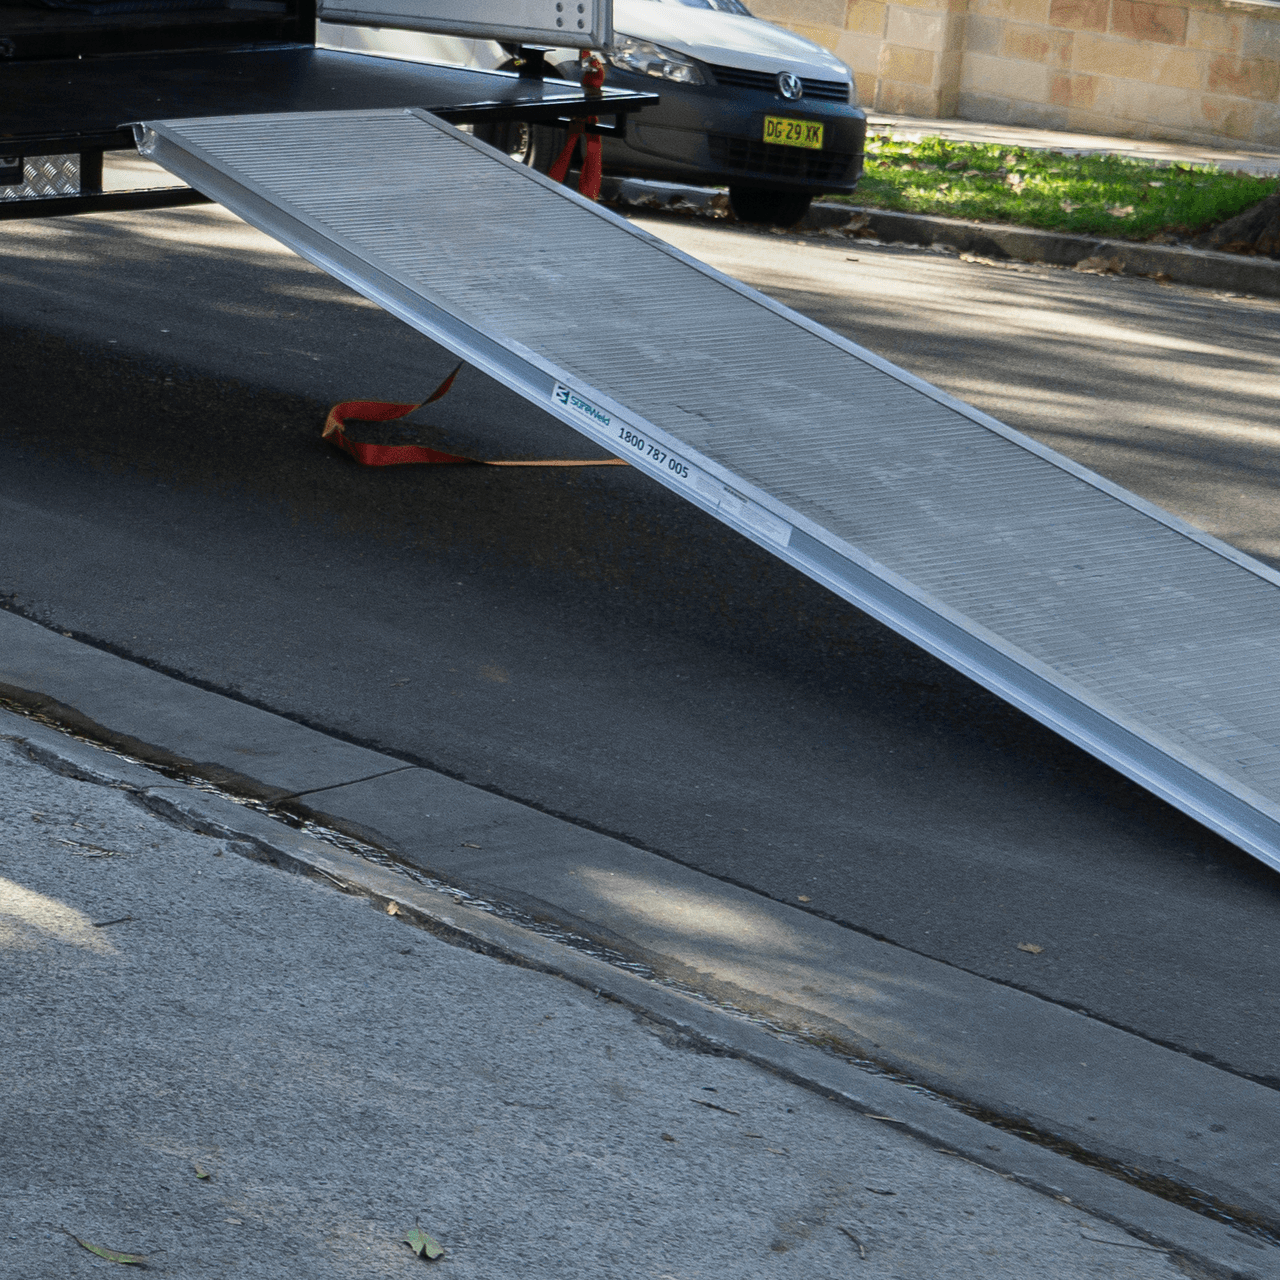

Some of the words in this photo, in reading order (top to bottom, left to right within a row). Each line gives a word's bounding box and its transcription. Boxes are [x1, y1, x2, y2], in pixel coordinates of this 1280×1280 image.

[786, 122, 802, 141] 29
[618, 427, 645, 451] 1800
[646, 444, 667, 464] 787
[668, 458, 690, 479] 005
